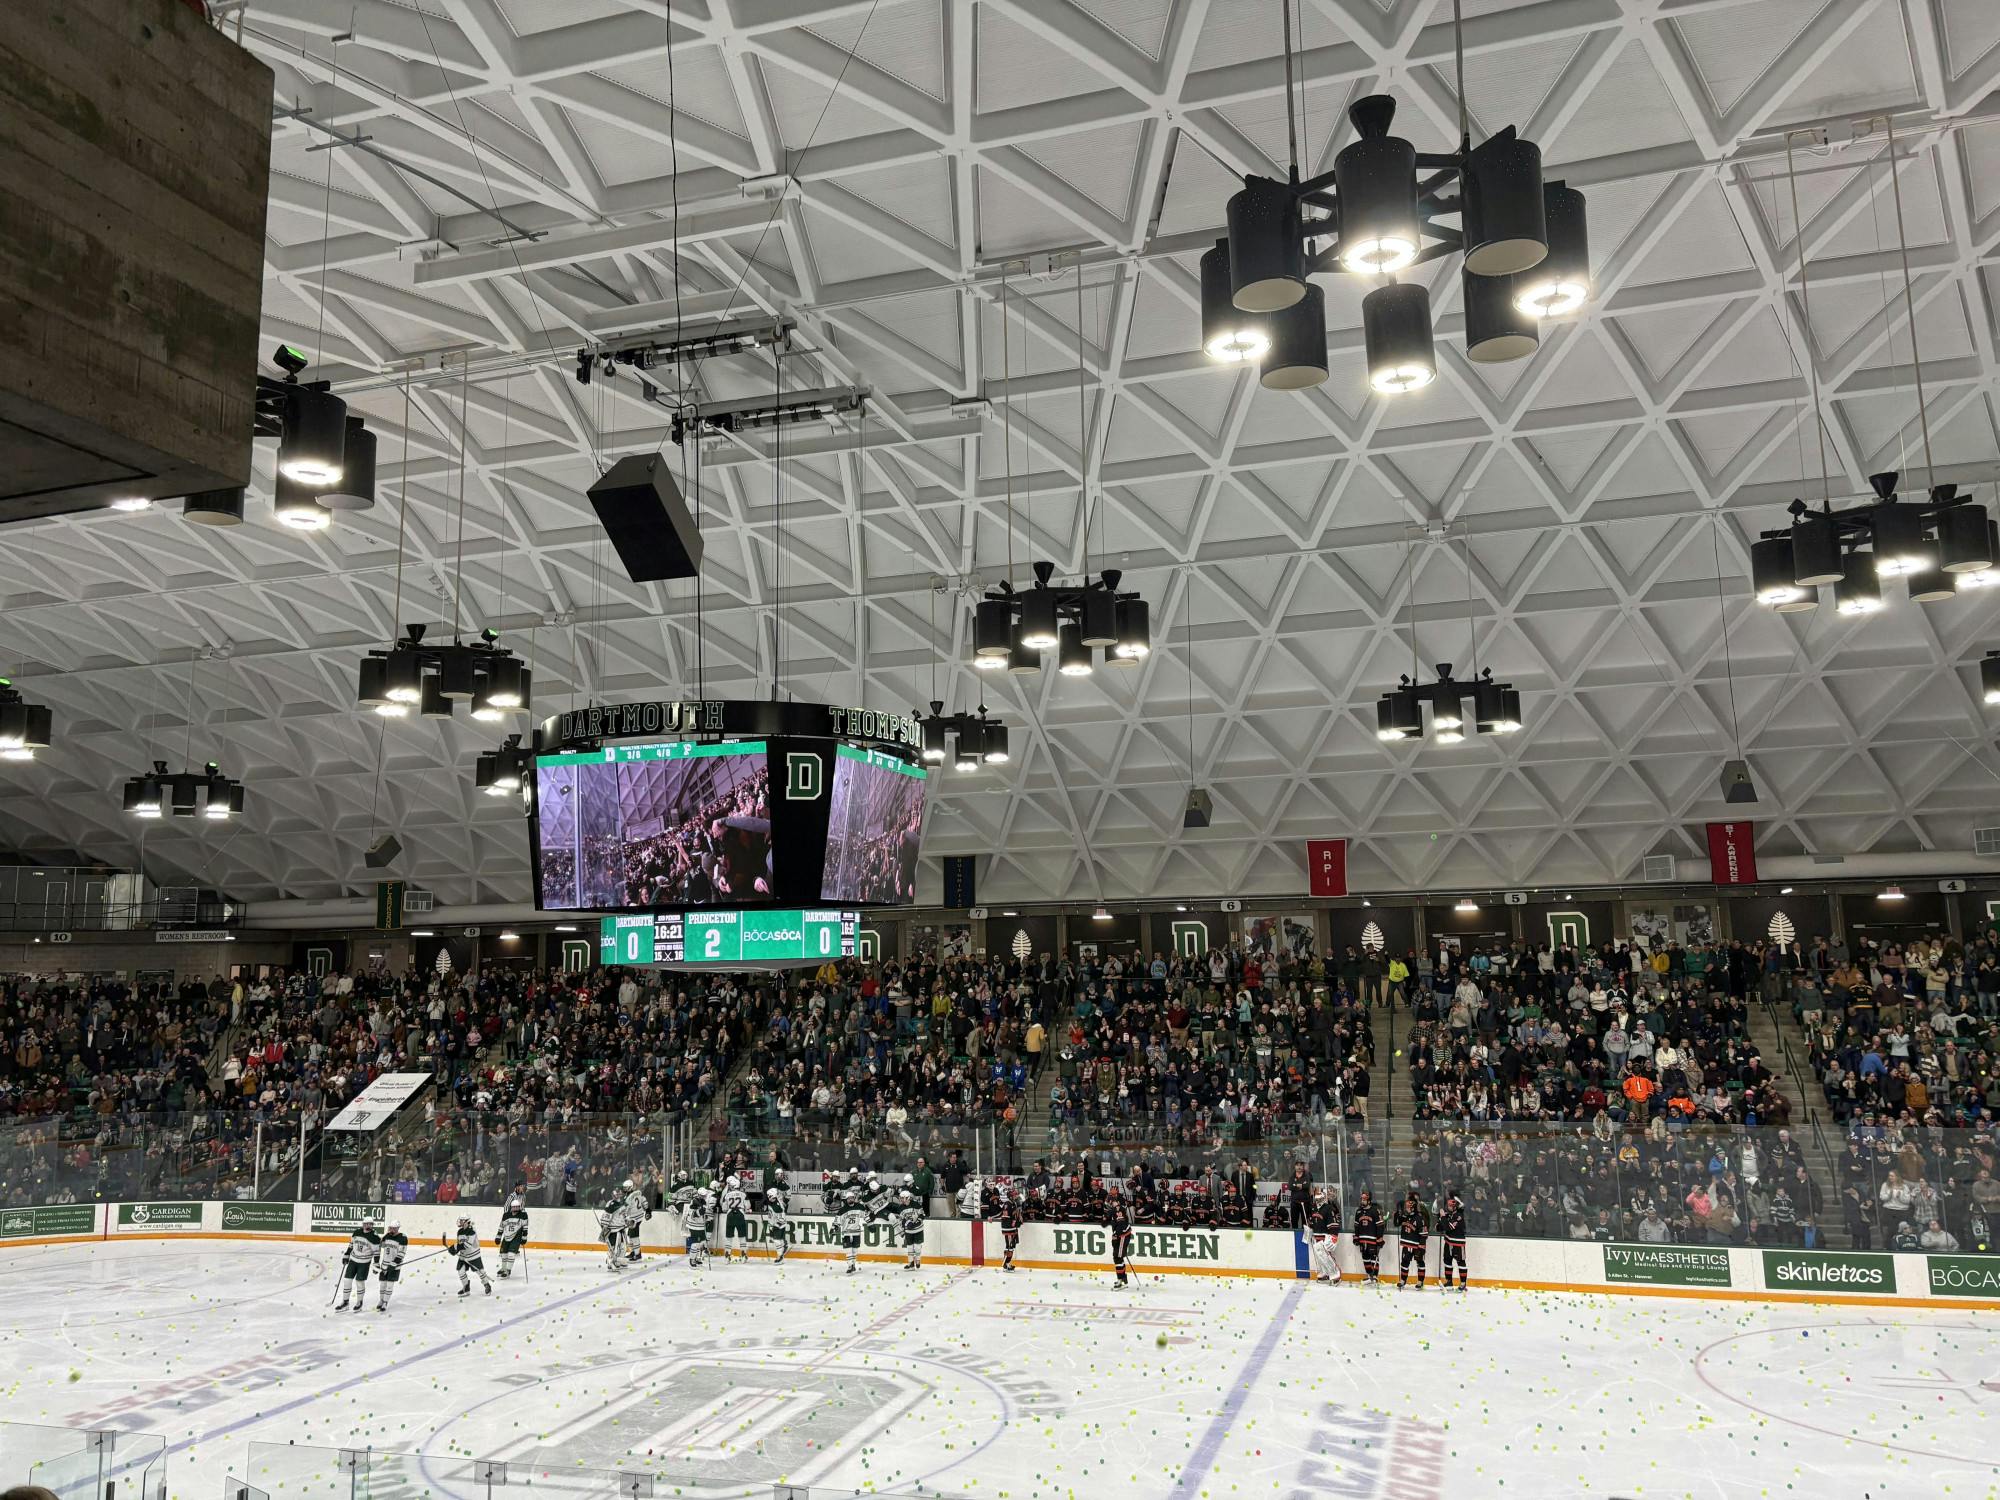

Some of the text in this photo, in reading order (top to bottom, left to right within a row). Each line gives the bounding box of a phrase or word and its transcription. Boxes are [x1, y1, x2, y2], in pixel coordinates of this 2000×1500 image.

[562, 702, 724, 739] DARTMOUTH
[829, 706, 921, 749] THOMPSON
[786, 752, 822, 800] D
[1323, 850, 1332, 886] RPI
[1947, 881, 1958, 891] 4
[1511, 894, 1521, 903] 5
[385, 883, 394, 929] CLARKSON
[1227, 901, 1236, 911] 6
[688, 913, 737, 924] PRINCETON
[975, 909, 983, 917] 7
[53, 933, 68, 942] 10
[159, 932, 227, 941] WOMEN'S RESTROOM
[654, 925, 683, 939] 16:21
[628, 932, 638, 960] 0
[705, 929, 720, 957] 2
[820, 927, 830, 954] 0
[655, 952, 662, 961] 15
[675, 951, 683, 960] 16
[1636, 1080, 1642, 1092] 1
[728, 1198, 742, 1209] 22
[152, 1207, 192, 1215] CARDIGAN
[312, 1205, 385, 1220] WILSON TIRE CO.
[1053, 1229, 1106, 1255] BIG
[1605, 1246, 1632, 1265] Ivy
